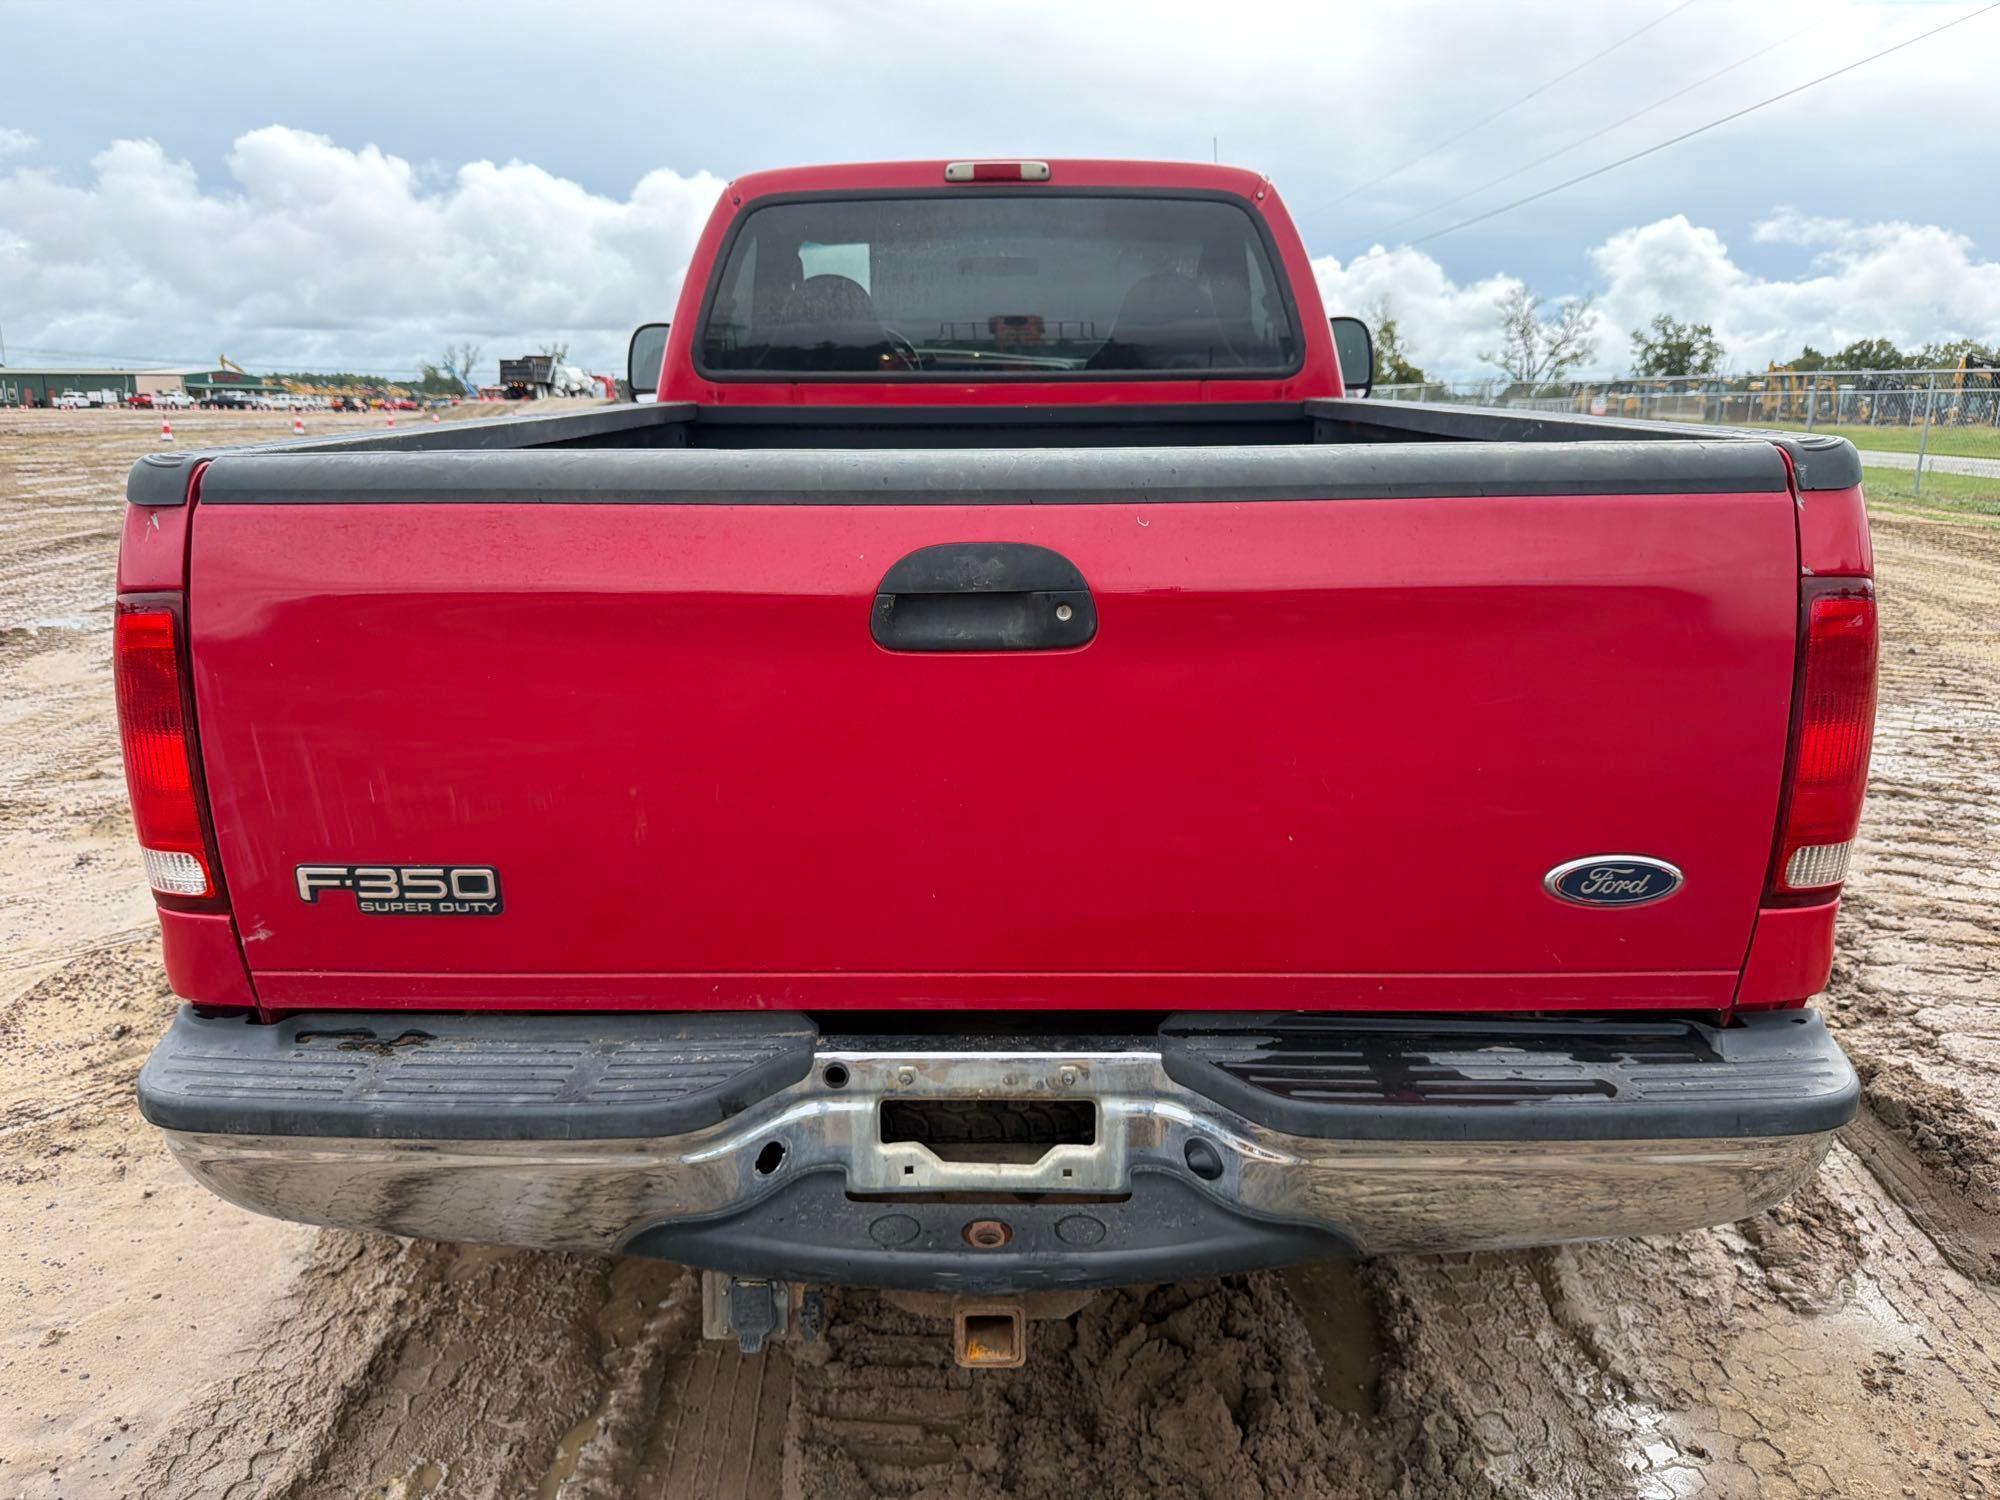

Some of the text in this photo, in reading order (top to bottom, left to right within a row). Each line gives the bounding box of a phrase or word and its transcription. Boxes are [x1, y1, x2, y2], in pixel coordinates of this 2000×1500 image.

[296, 867, 497, 901] F-350
[1580, 867, 1652, 894] Ford
[360, 902, 498, 913] SUPER DUTY
